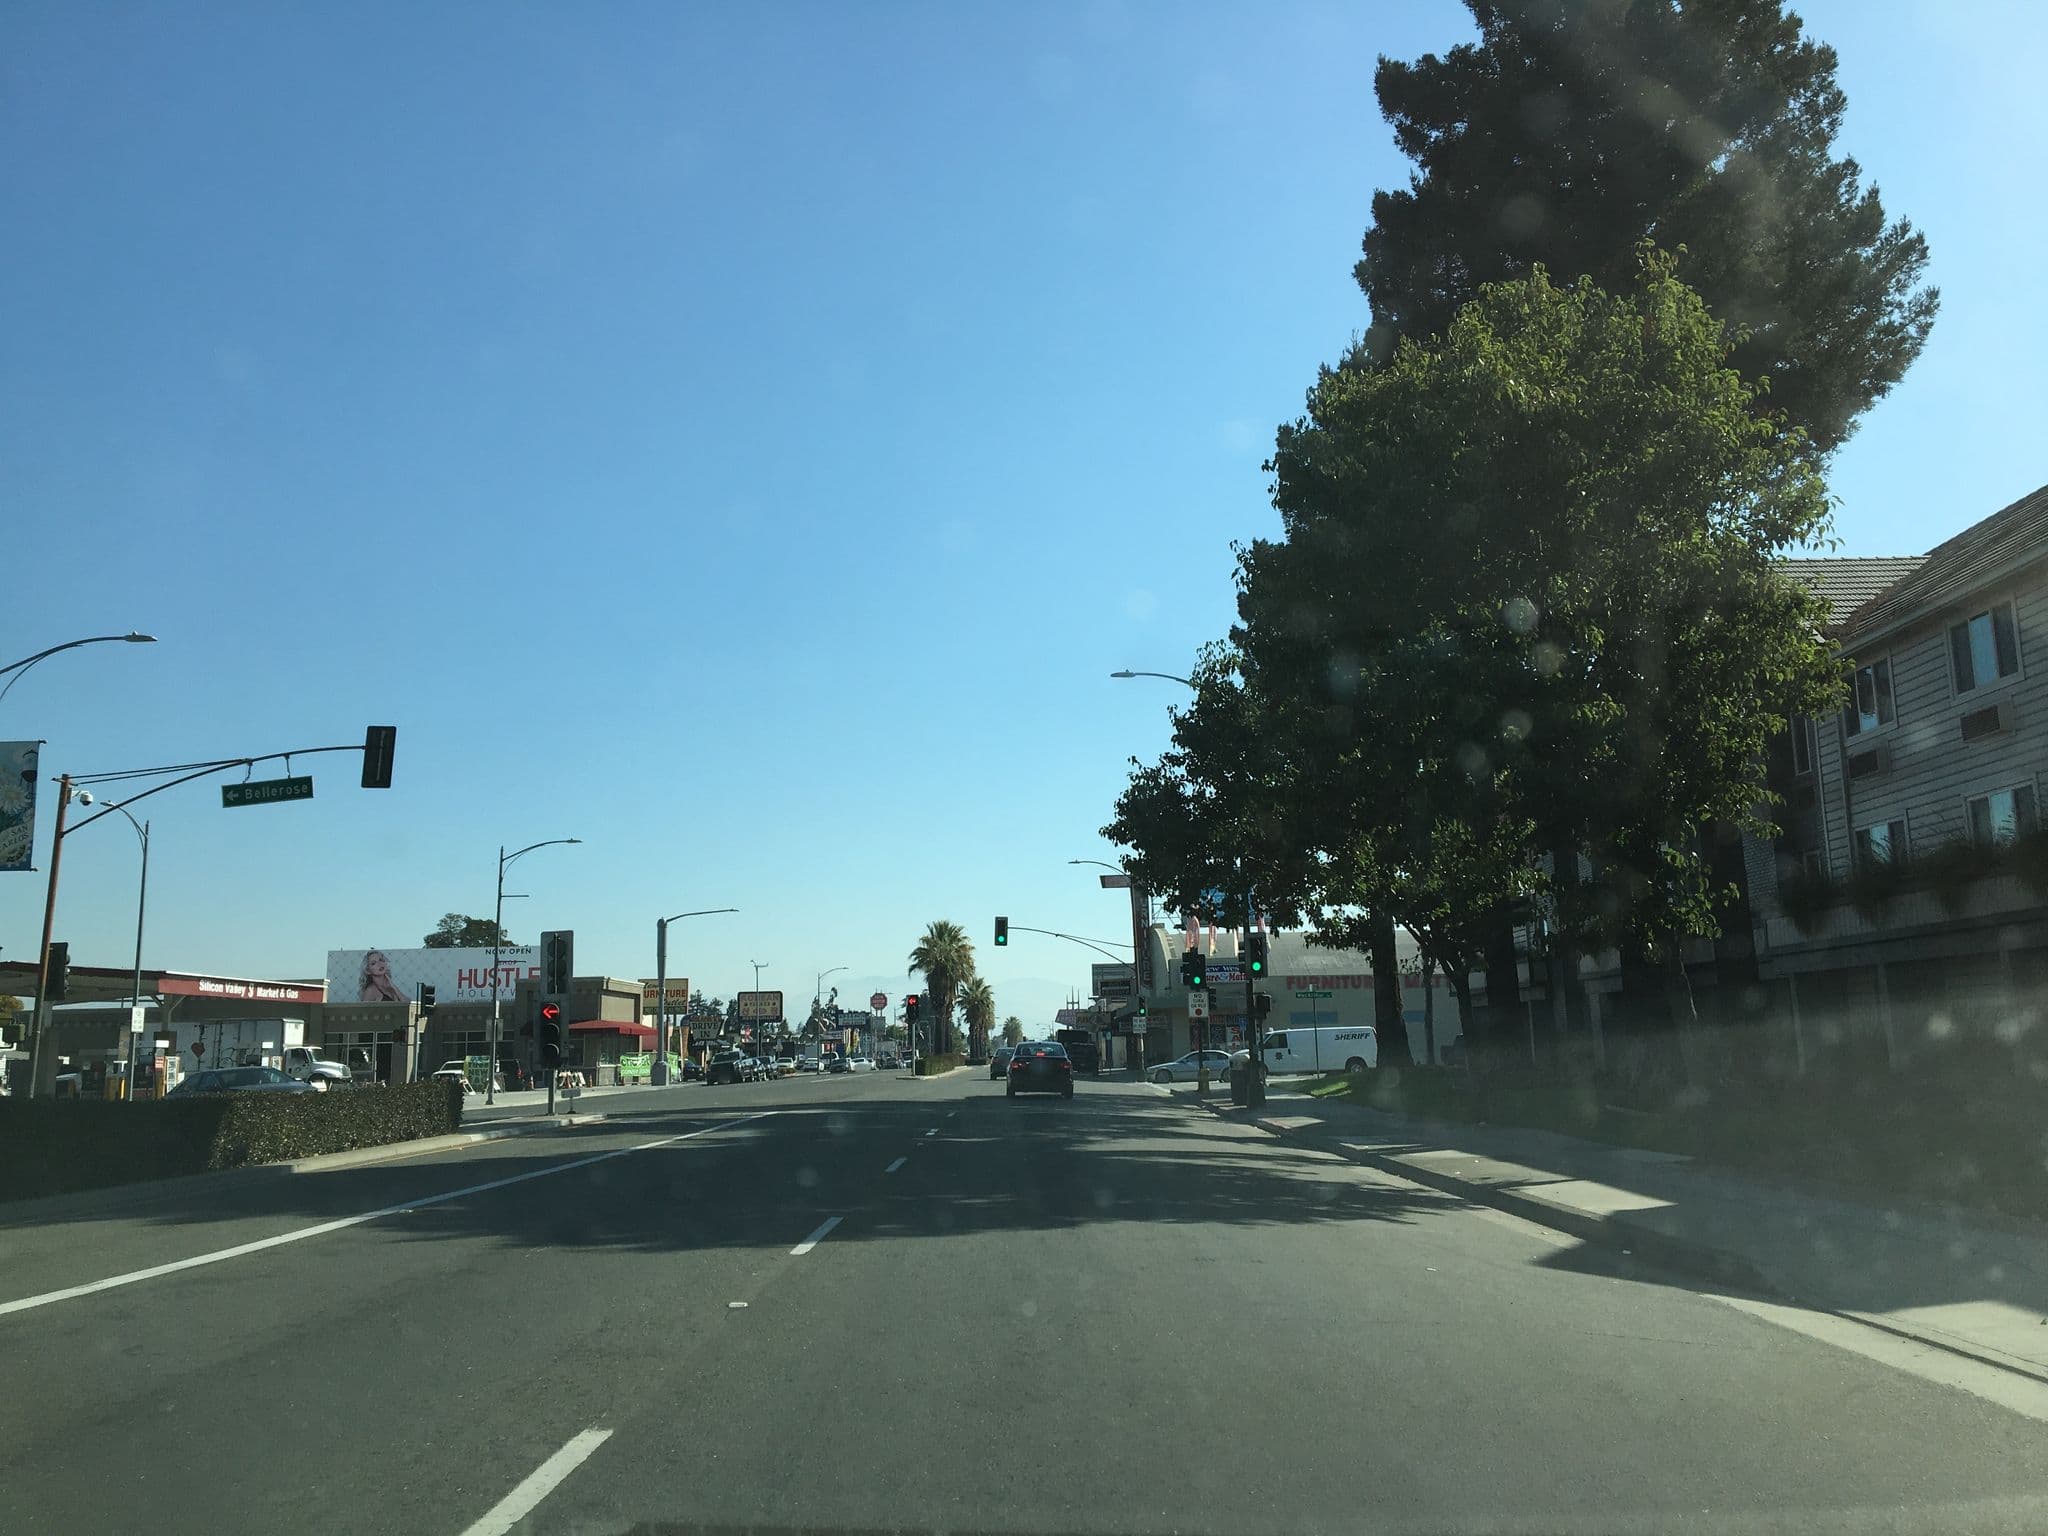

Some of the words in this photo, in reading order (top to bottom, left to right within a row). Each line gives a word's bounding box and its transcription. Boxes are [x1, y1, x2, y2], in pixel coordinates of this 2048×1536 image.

[245, 784, 308, 799] Bellerose
[199, 979, 224, 993] Silicon
[225, 982, 246, 998] Valley
[257, 987, 279, 998] Market
[279, 988, 285, 998] &
[286, 988, 299, 999] Gas
[692, 1022, 718, 1030] DRIVE
[1335, 1033, 1370, 1041] SHERIFF
